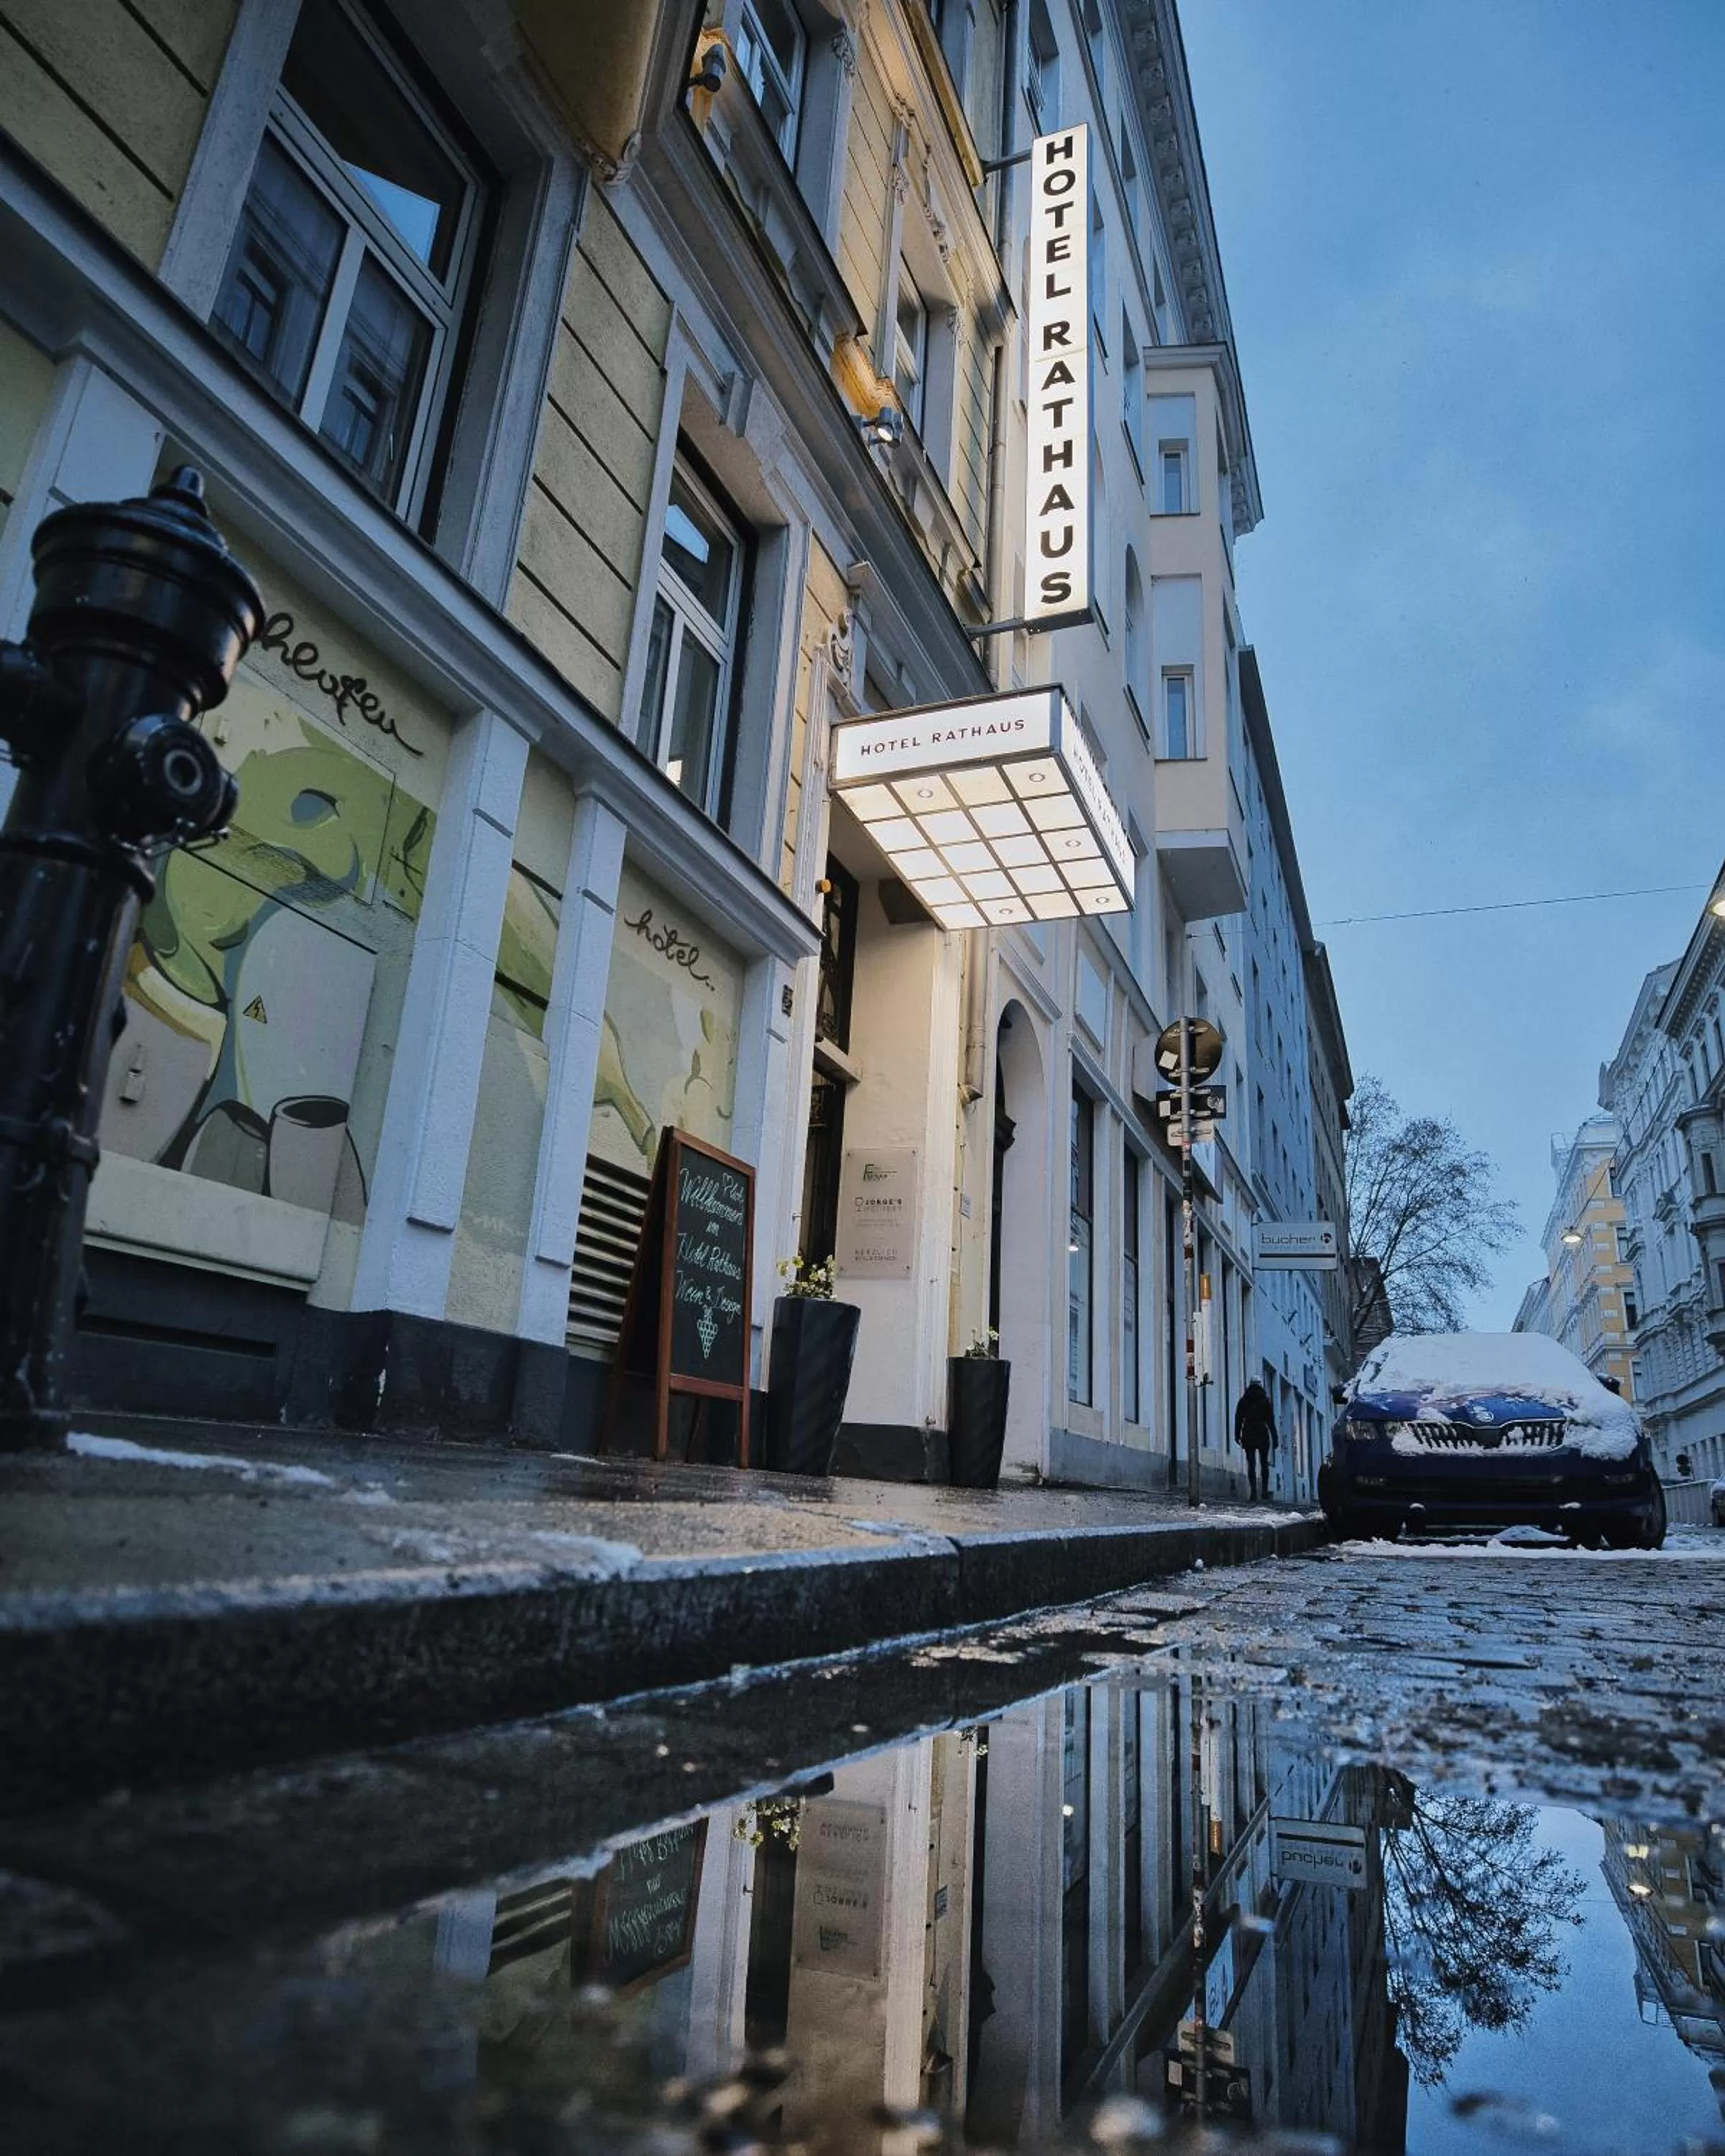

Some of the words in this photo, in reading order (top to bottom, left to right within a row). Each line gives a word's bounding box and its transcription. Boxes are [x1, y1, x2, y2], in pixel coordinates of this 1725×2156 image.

[1042, 134, 1075, 300] HOTEL
[1039, 320, 1076, 605] RATHAUS
[860, 737, 921, 757] HOTEL
[931, 719, 1026, 744] RATHAUS
[678, 1167, 743, 1225] Willkommen
[1261, 1233, 1316, 1245] bucher
